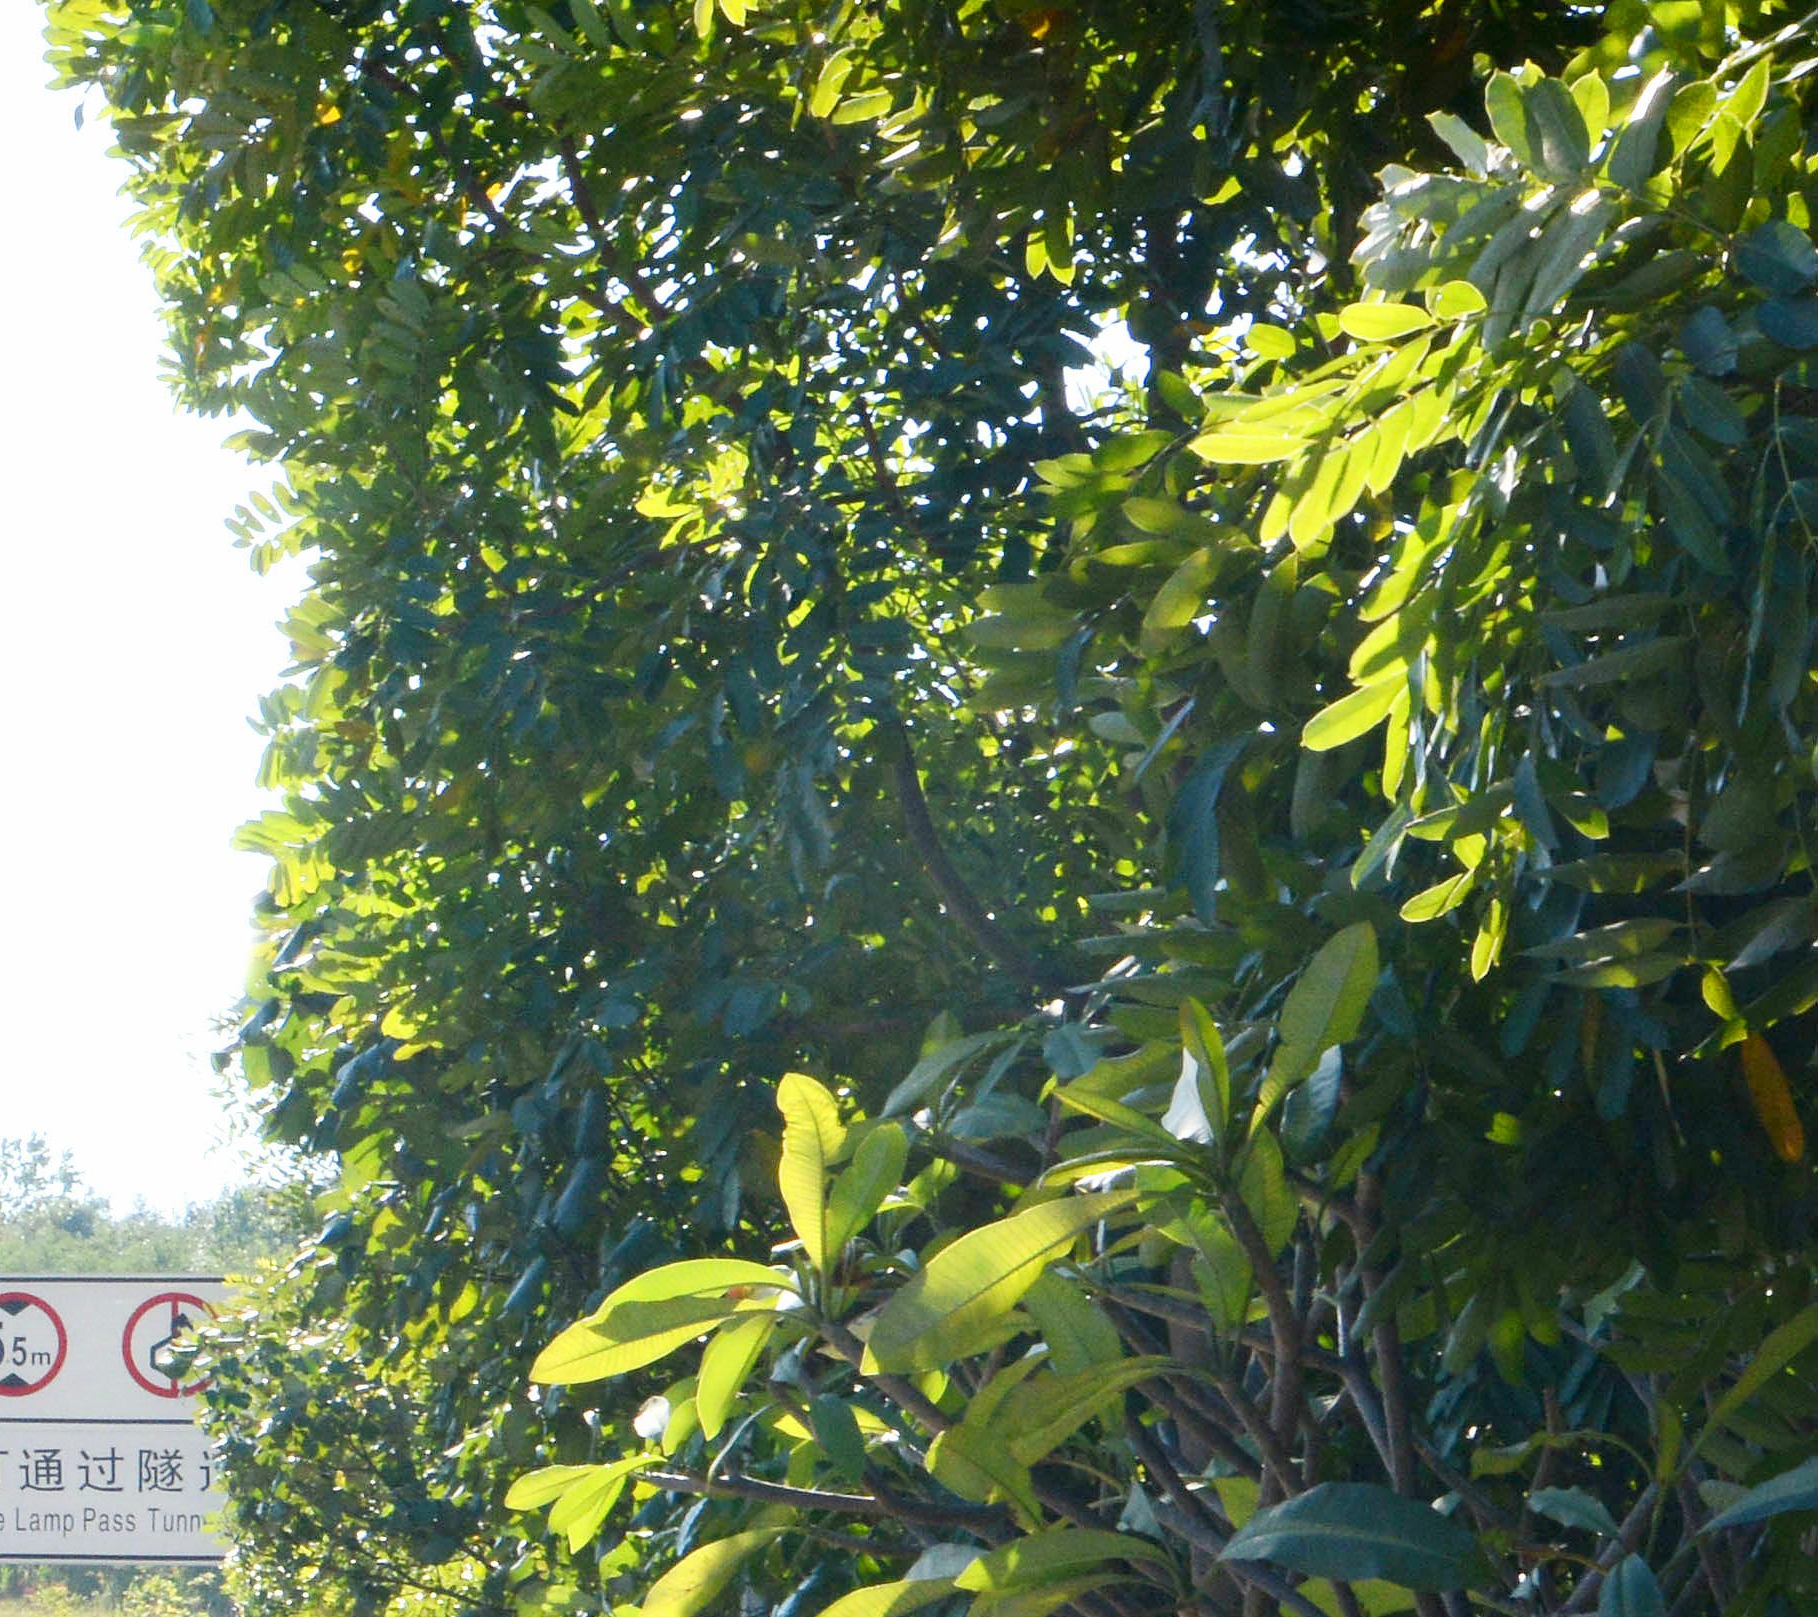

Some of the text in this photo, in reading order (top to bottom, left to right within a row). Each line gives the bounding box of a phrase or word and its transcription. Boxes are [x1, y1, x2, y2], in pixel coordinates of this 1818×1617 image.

[16, 1508, 74, 1537] Lamp
[83, 1508, 135, 1532] Pass
[147, 1507, 205, 1533] Tunn
